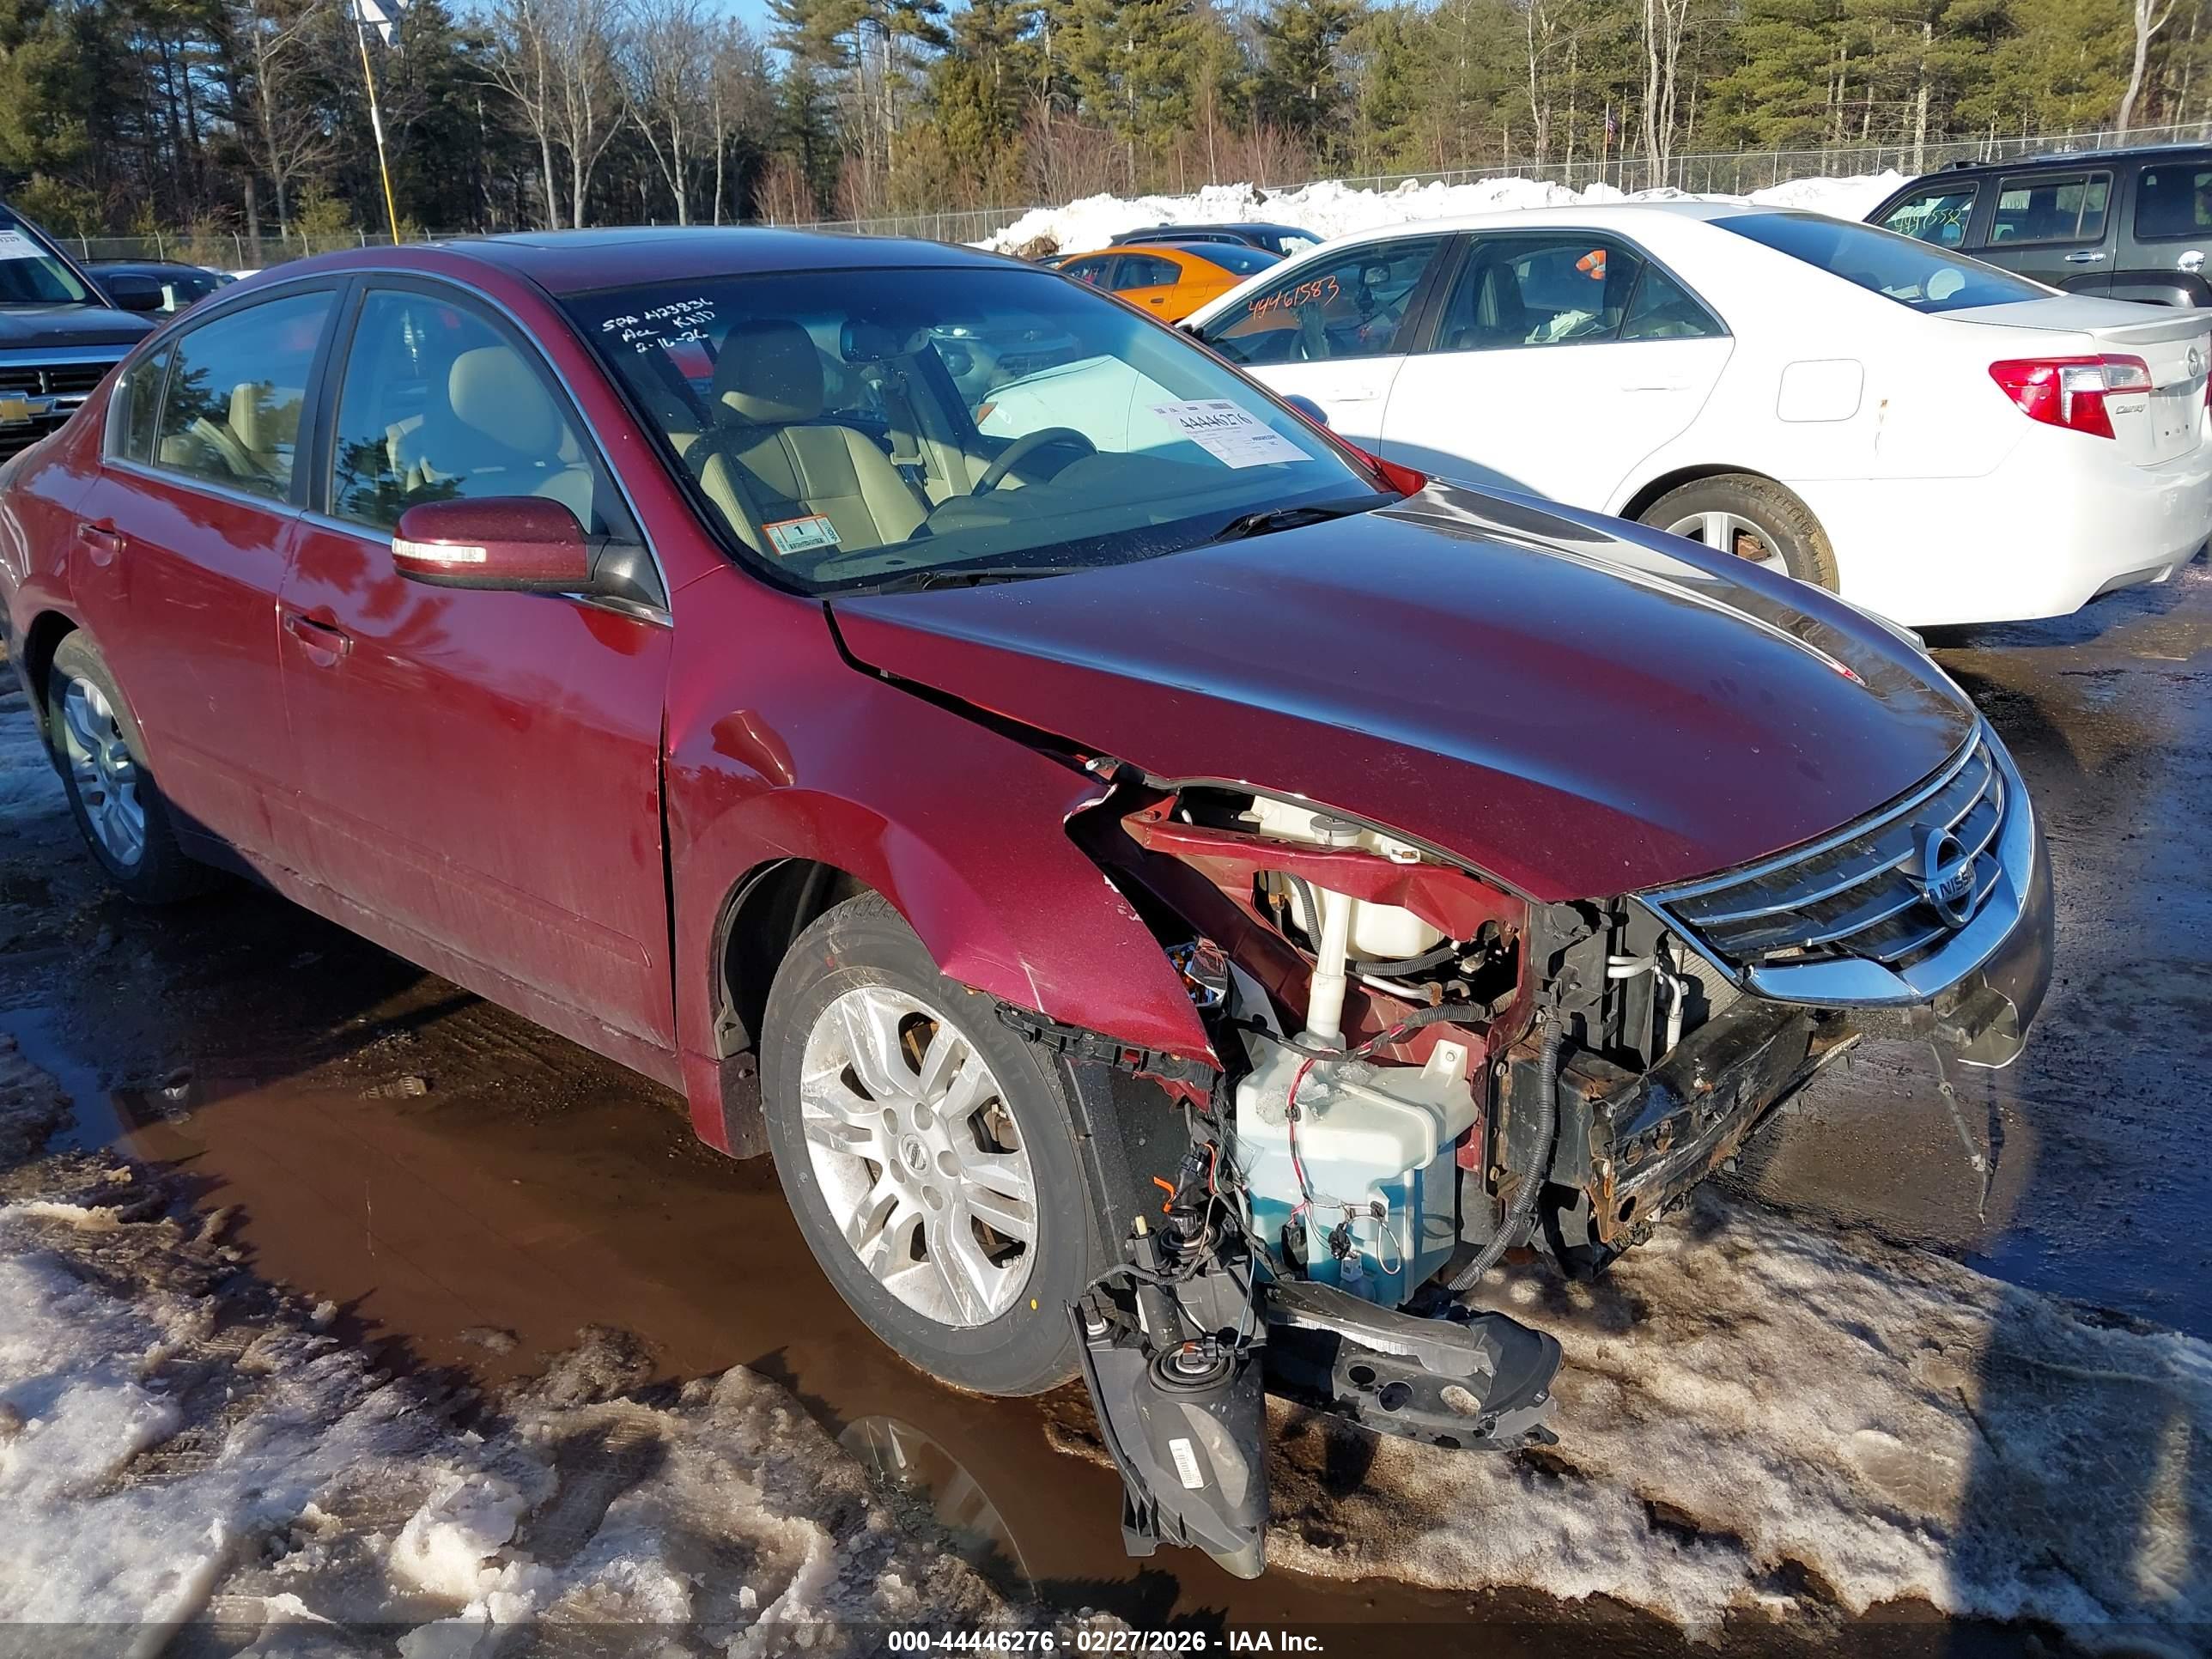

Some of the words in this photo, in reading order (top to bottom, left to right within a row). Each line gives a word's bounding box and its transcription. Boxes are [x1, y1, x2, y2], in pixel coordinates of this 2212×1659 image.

[1249, 276, 1340, 320] 44461583
[1179, 412, 1253, 430] 44446276
[793, 526, 804, 536] 1
